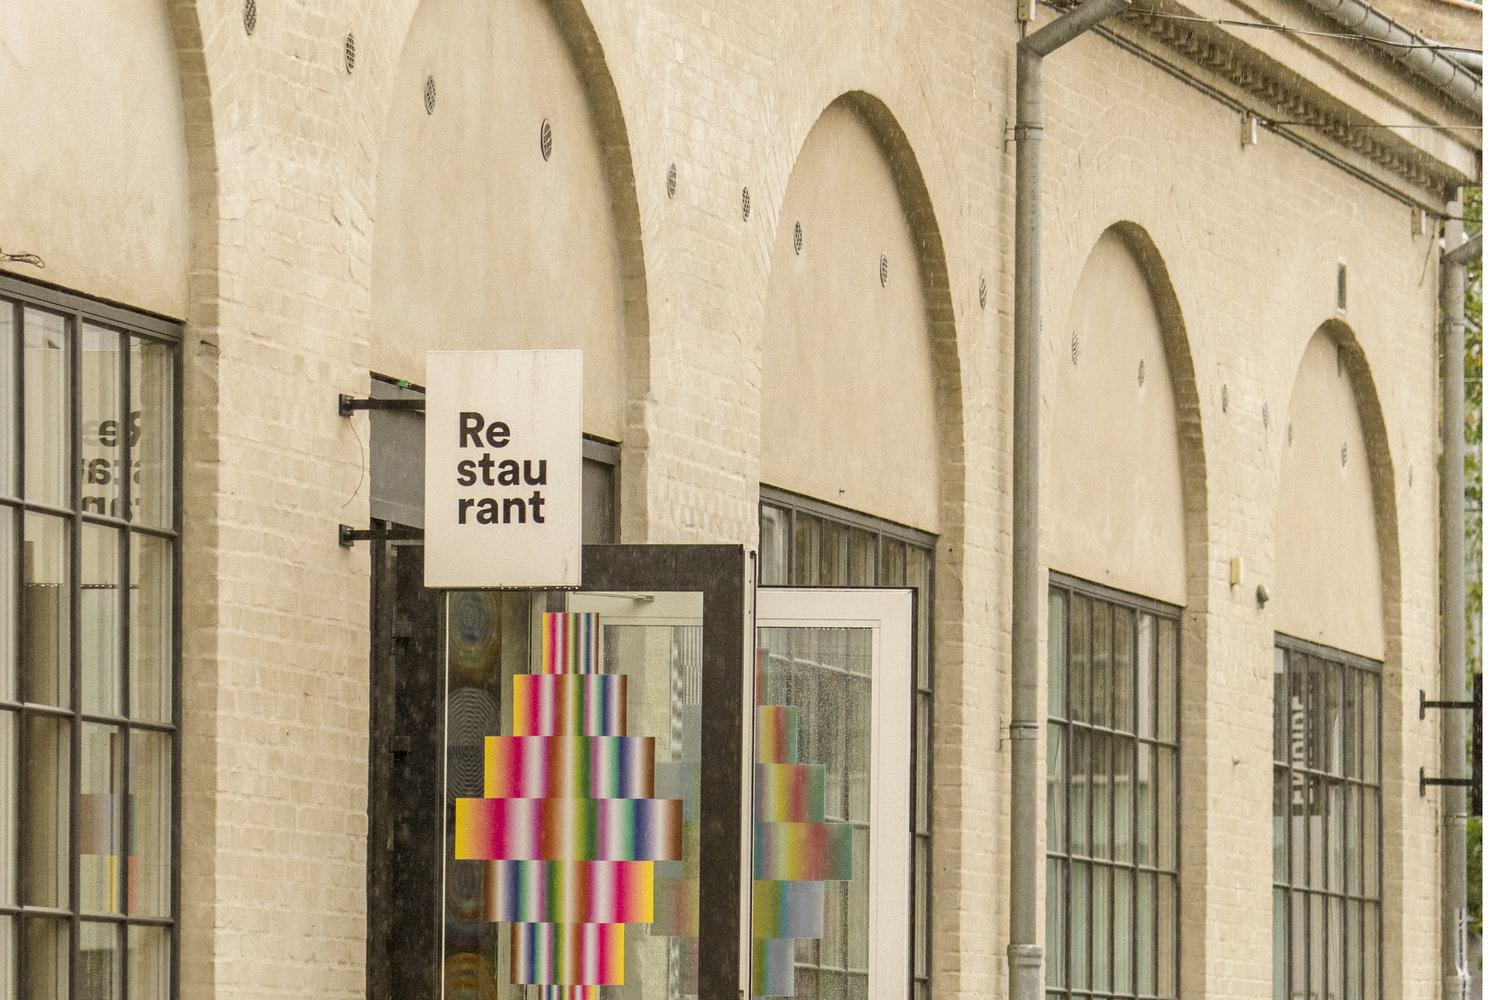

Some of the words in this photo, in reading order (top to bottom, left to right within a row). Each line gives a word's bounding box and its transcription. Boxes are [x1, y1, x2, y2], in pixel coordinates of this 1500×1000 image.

[459, 411, 511, 448] Re
[457, 453, 547, 486] stau
[458, 491, 545, 524] rant
